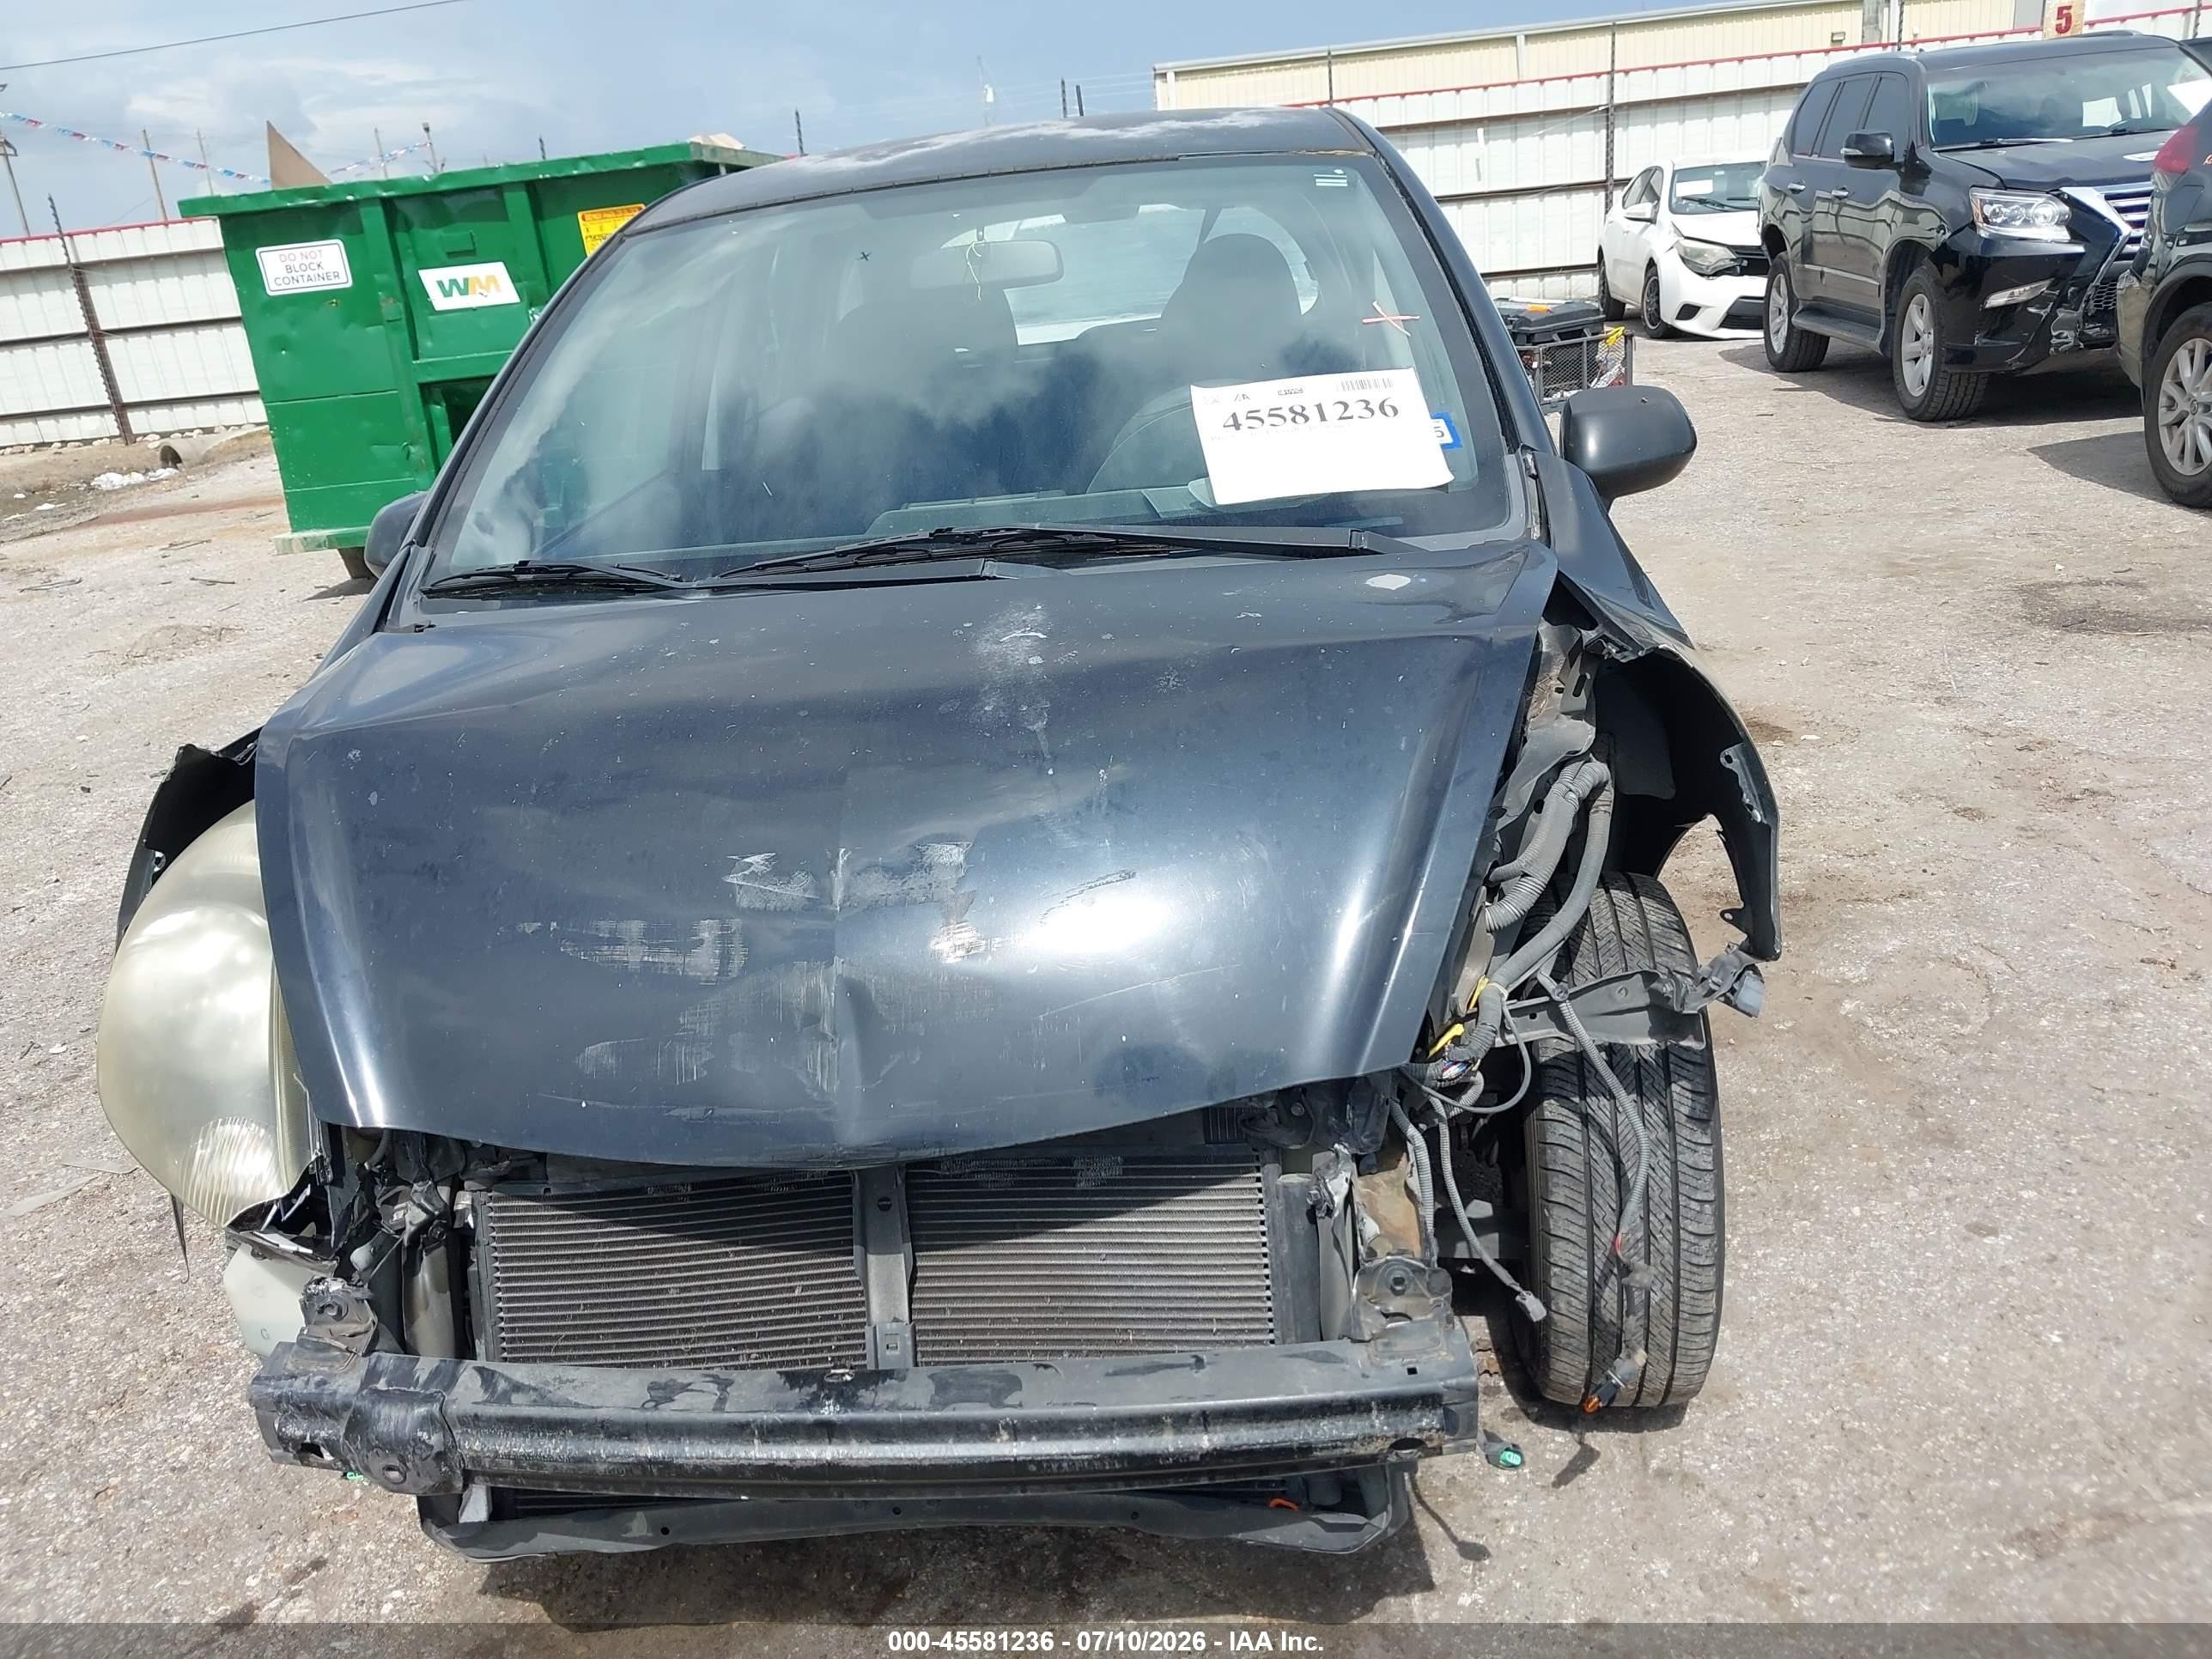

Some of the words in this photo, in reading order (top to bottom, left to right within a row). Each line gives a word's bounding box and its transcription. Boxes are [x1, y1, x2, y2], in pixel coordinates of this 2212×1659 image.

[2055, 5, 2073, 34] 5
[279, 252, 297, 263] DO
[300, 249, 323, 260] NOT
[285, 261, 325, 274] BLOCK
[274, 270, 341, 286] CONTAINER
[435, 274, 502, 298] WM
[1223, 397, 1399, 431] 45581236
